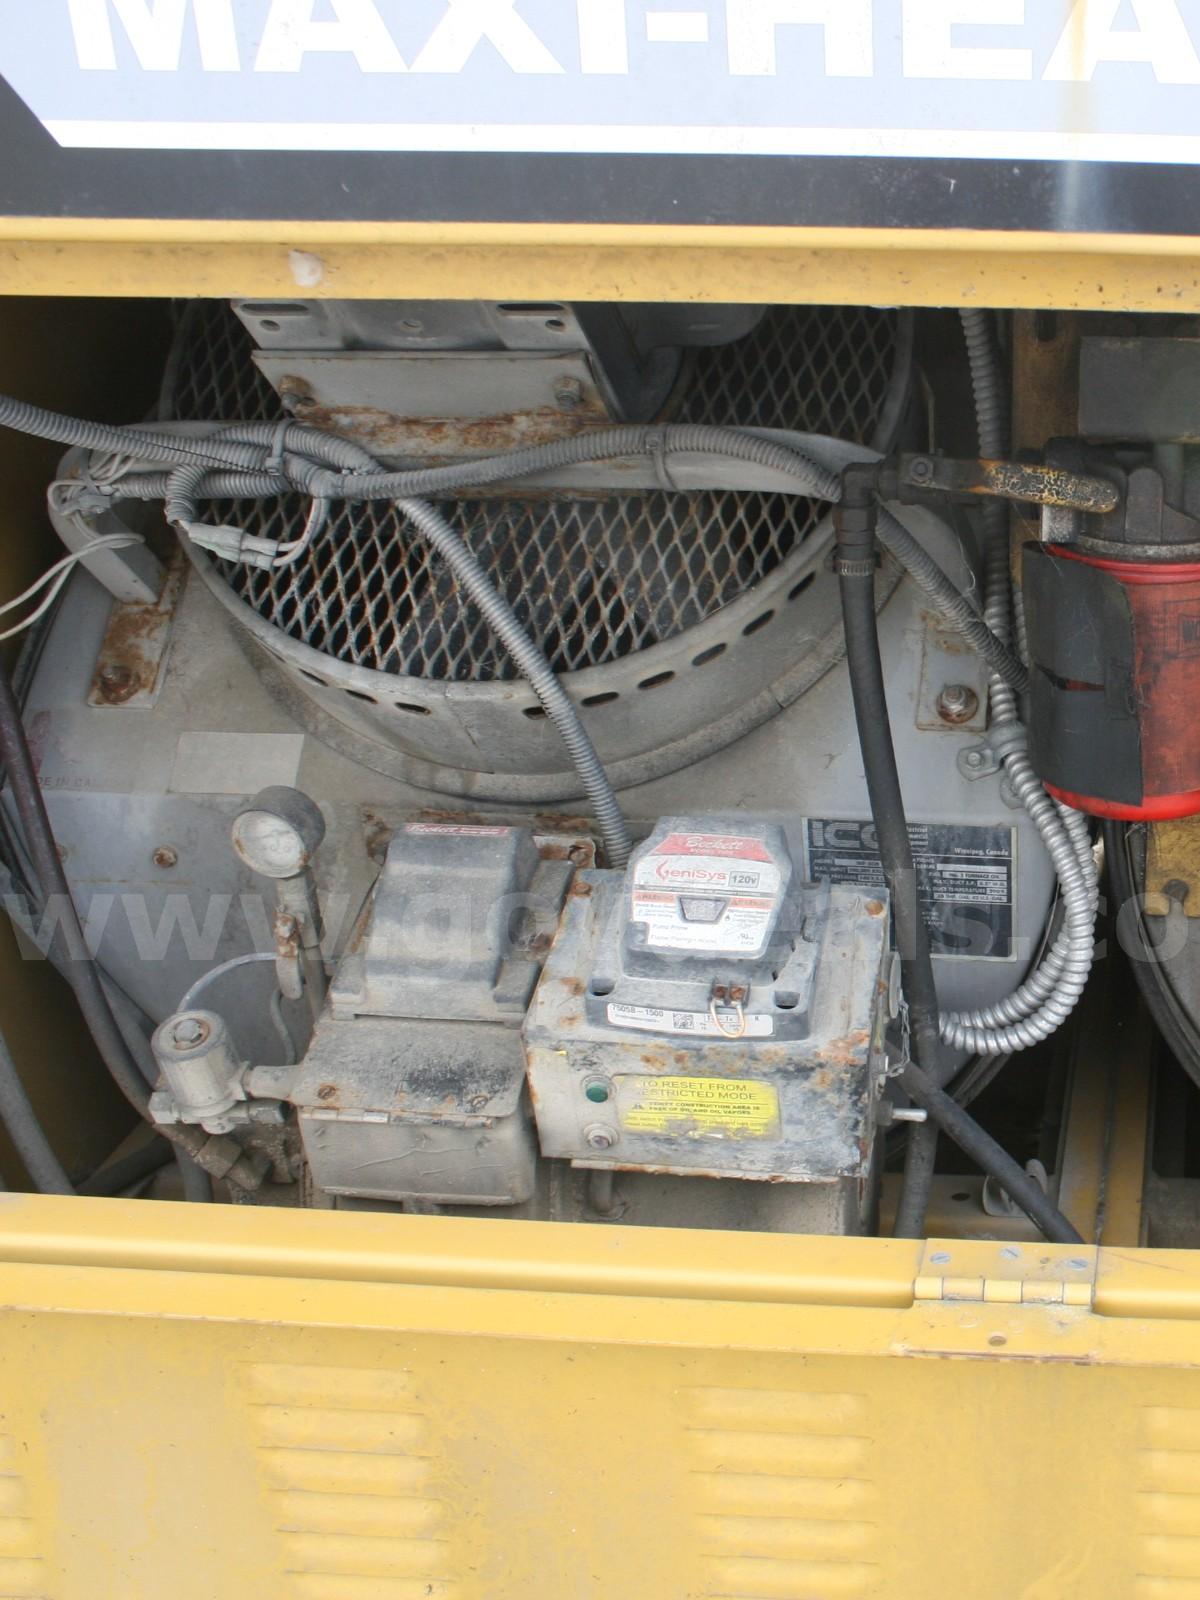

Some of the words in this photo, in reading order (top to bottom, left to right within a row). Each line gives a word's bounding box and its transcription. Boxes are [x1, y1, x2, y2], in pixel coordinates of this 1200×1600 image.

[685, 836, 744, 851] Beckett
[655, 859, 727, 881] GeniSys
[662, 1080, 704, 1089] RESET
[708, 1082, 746, 1091] FROM
[640, 1088, 714, 1099] ESTRICTED
[718, 1090, 757, 1100] MODE
